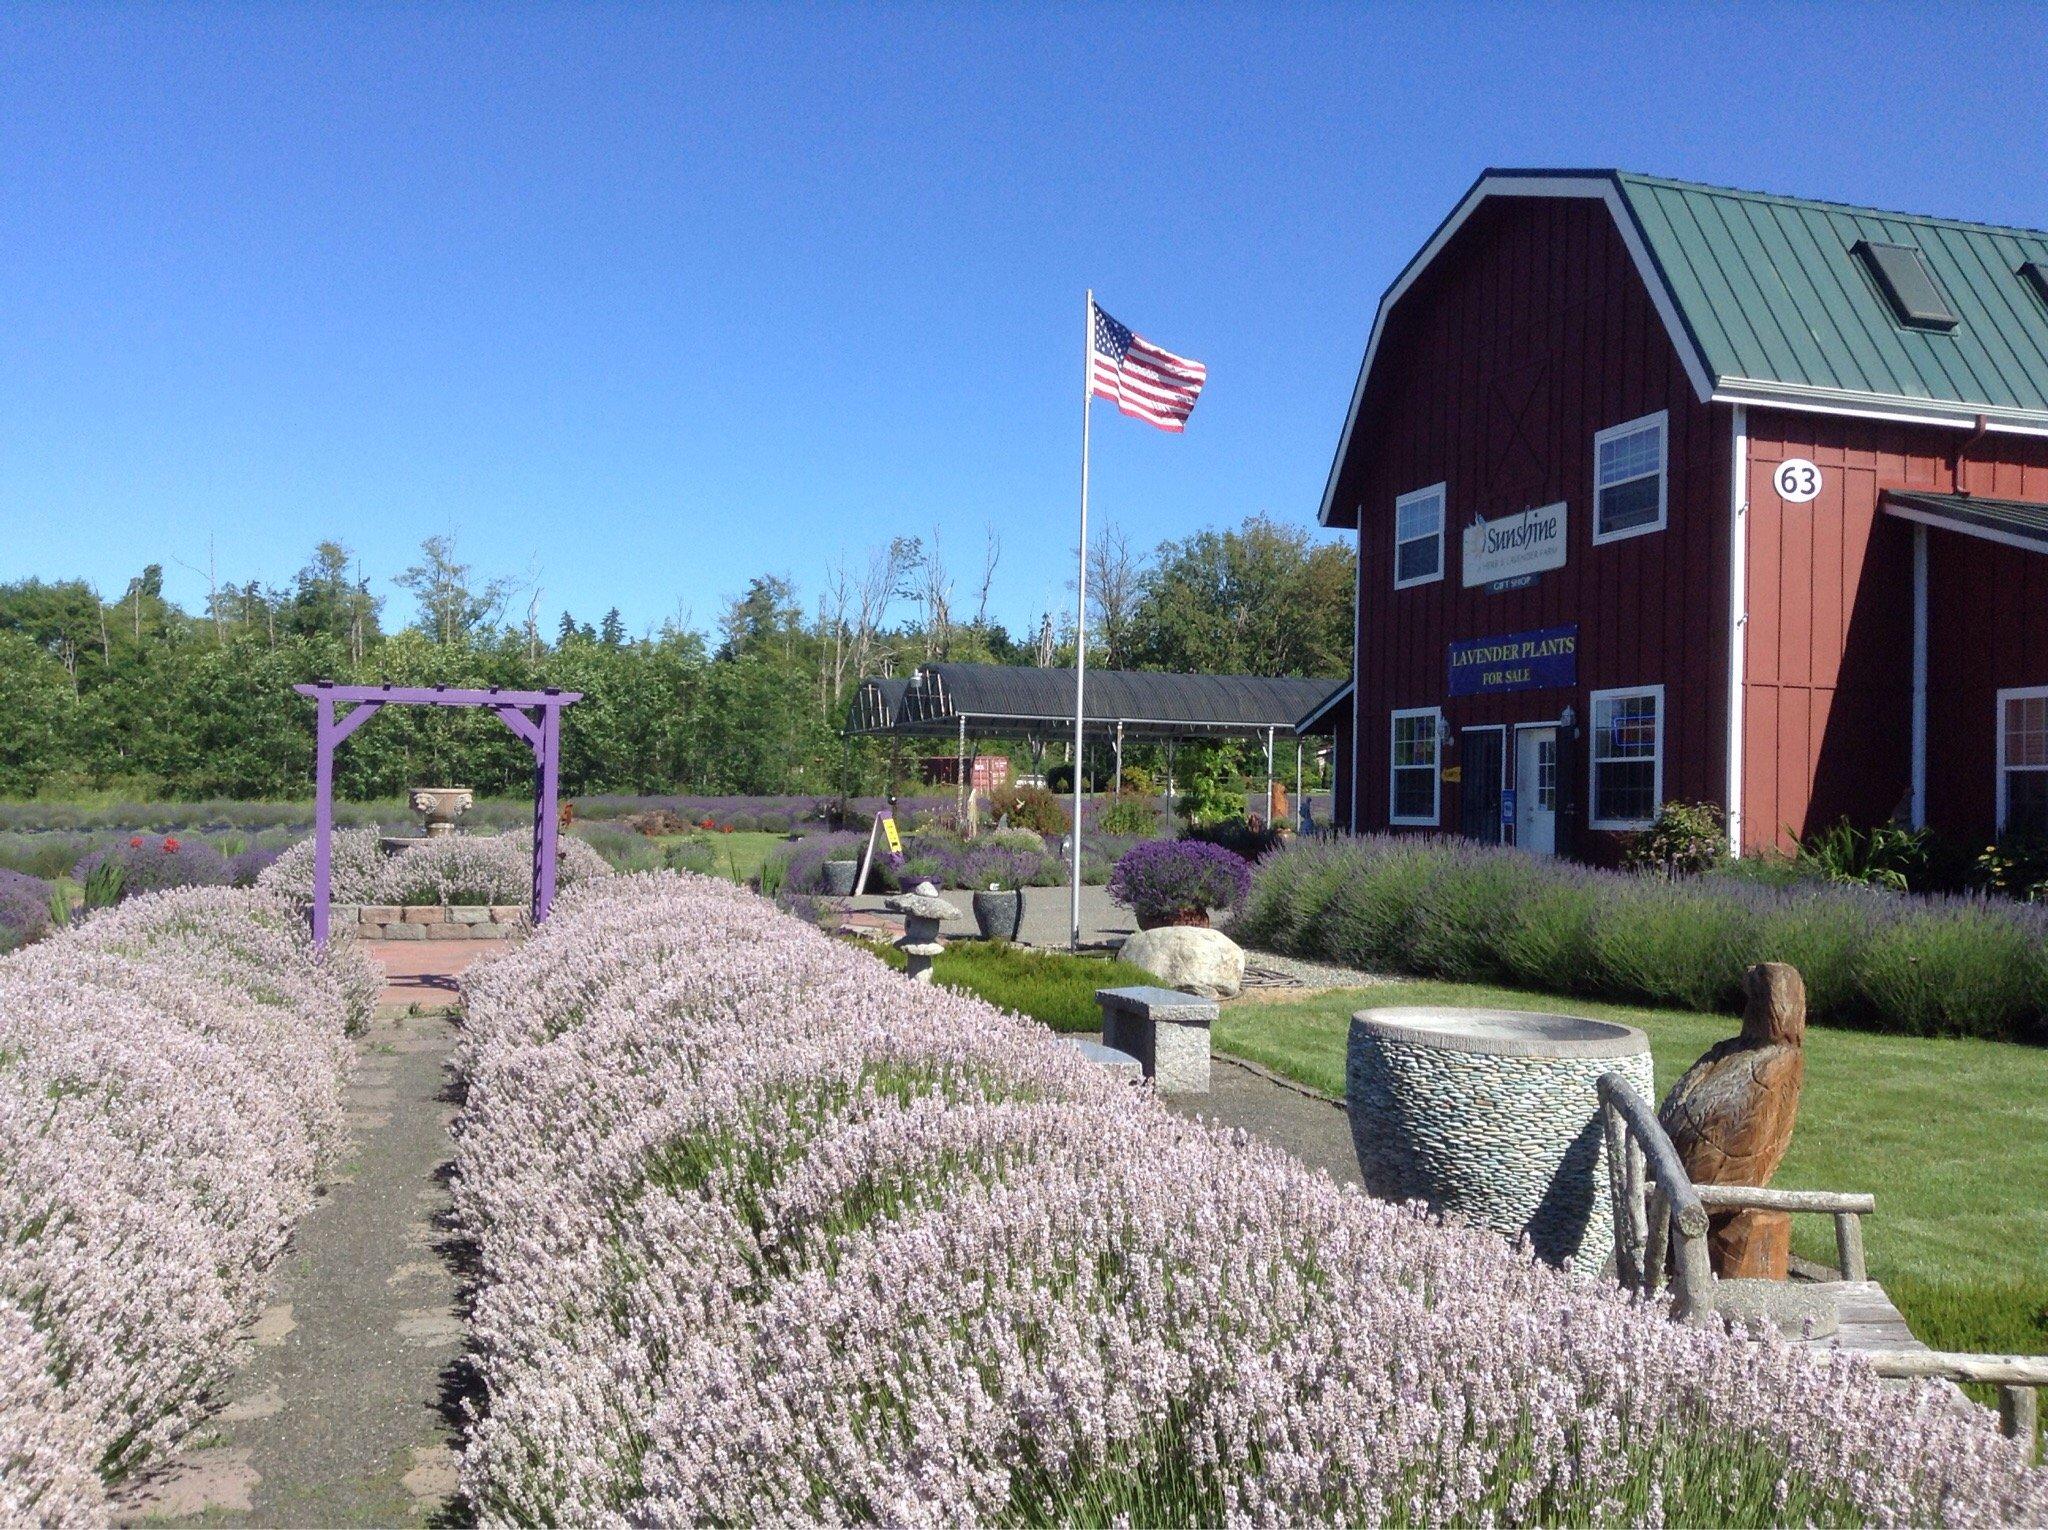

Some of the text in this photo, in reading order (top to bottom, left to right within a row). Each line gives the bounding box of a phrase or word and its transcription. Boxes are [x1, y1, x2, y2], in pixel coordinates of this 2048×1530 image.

[1781, 466, 1816, 495] 63
[1488, 508, 1557, 553] Sunshine
[1493, 579, 1510, 591] GIFT
[1452, 636, 1575, 667] LAVENDER PLANTS
[1482, 668, 1531, 685] FOR SALE
